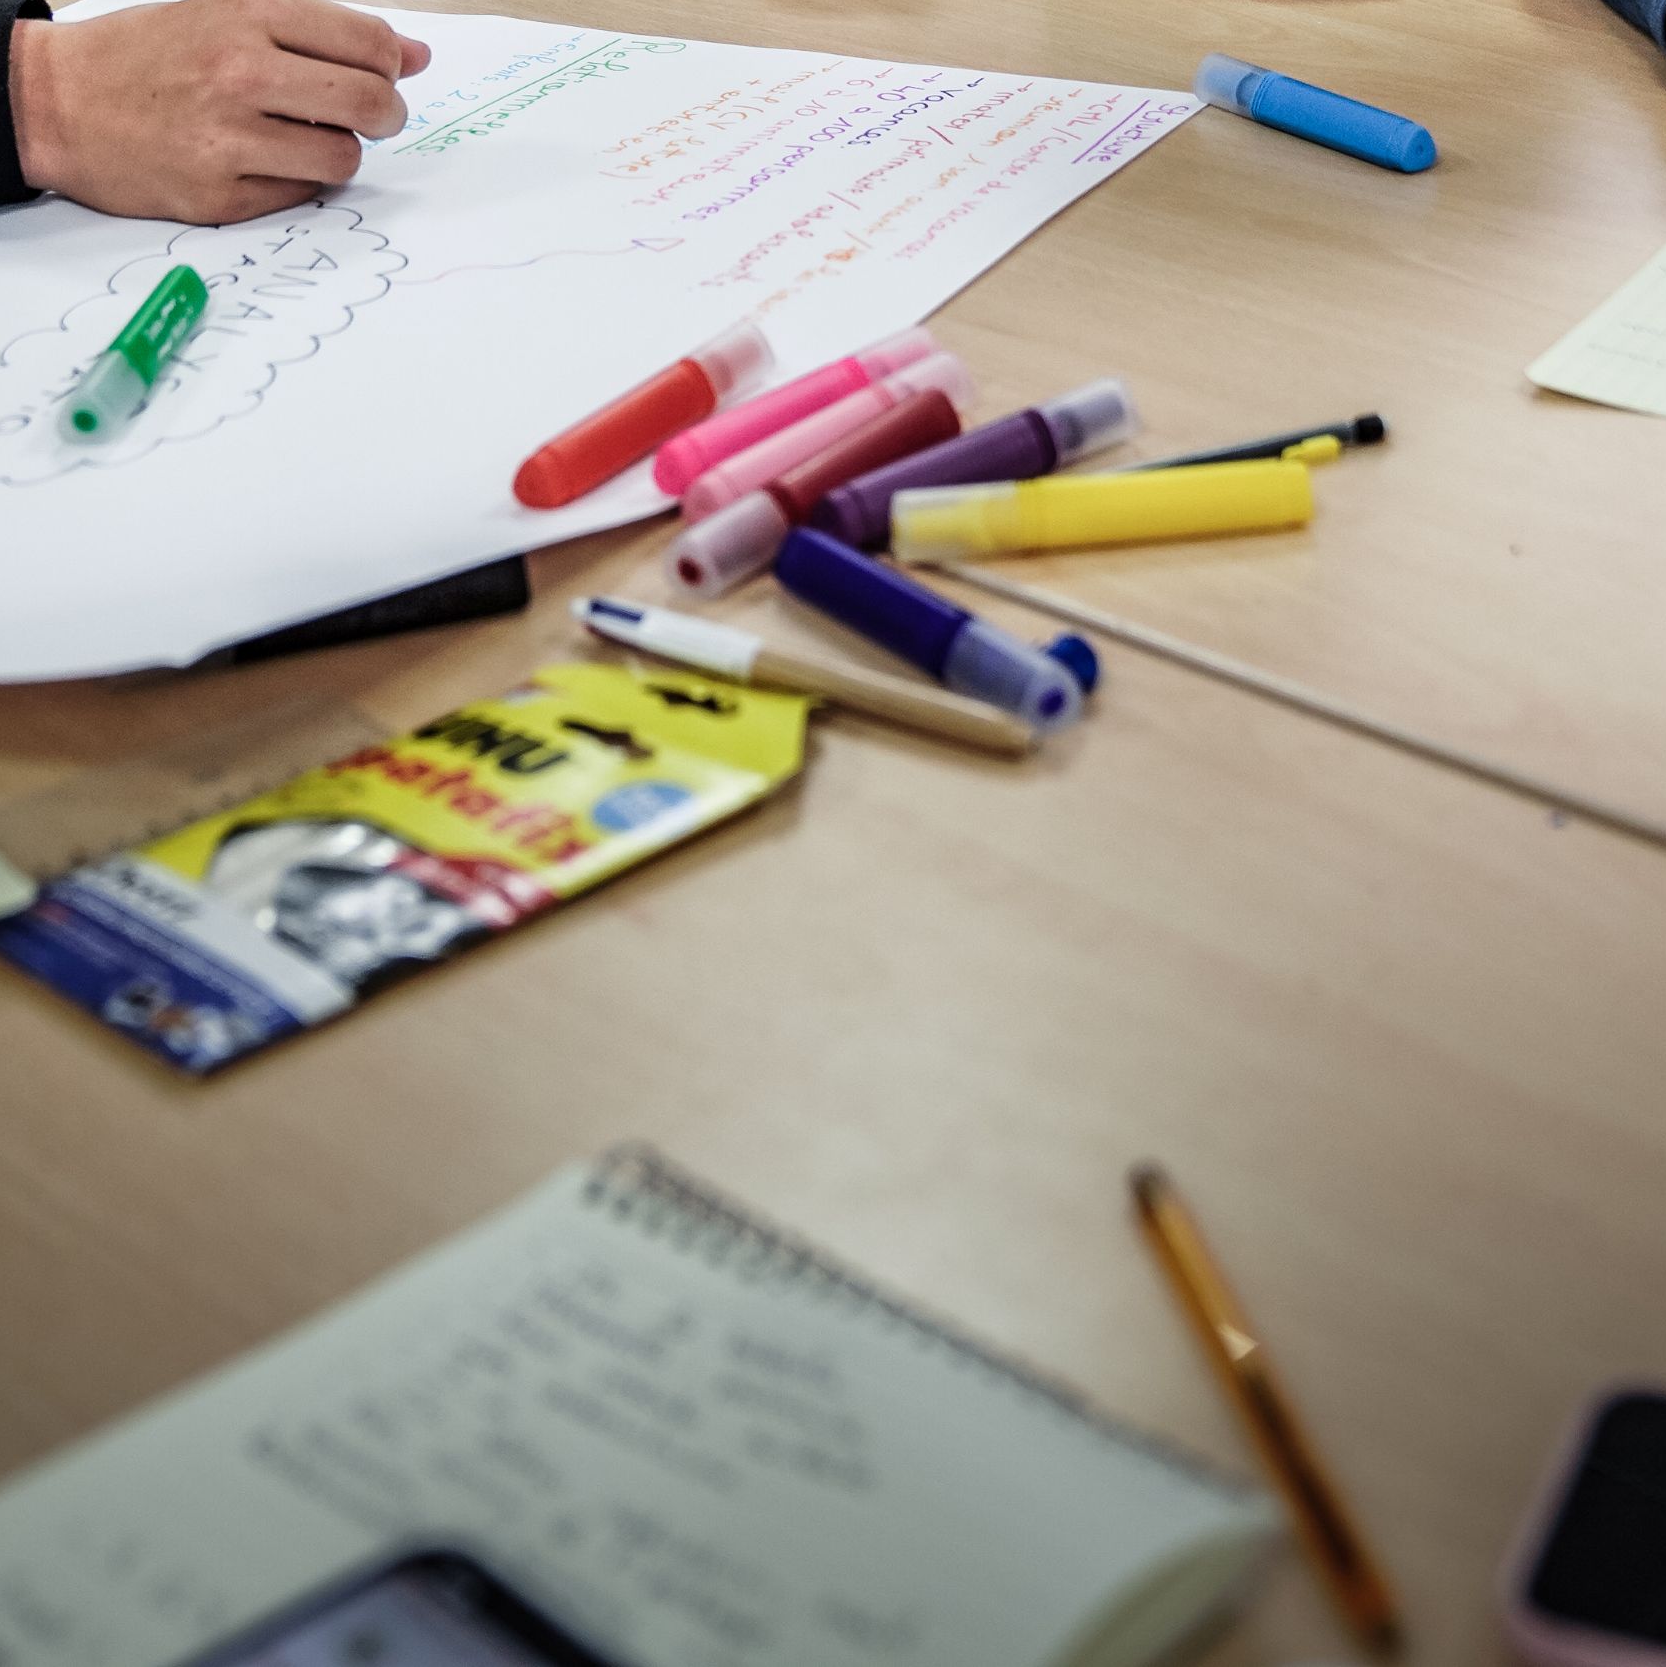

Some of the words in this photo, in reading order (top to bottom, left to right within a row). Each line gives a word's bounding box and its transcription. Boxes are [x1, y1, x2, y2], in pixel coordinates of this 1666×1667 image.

[846, 78, 879, 89] 6
[446, 89, 479, 100] 2
[876, 85, 924, 101] 40
[795, 100, 827, 116] 10
[808, 118, 853, 142] 100
